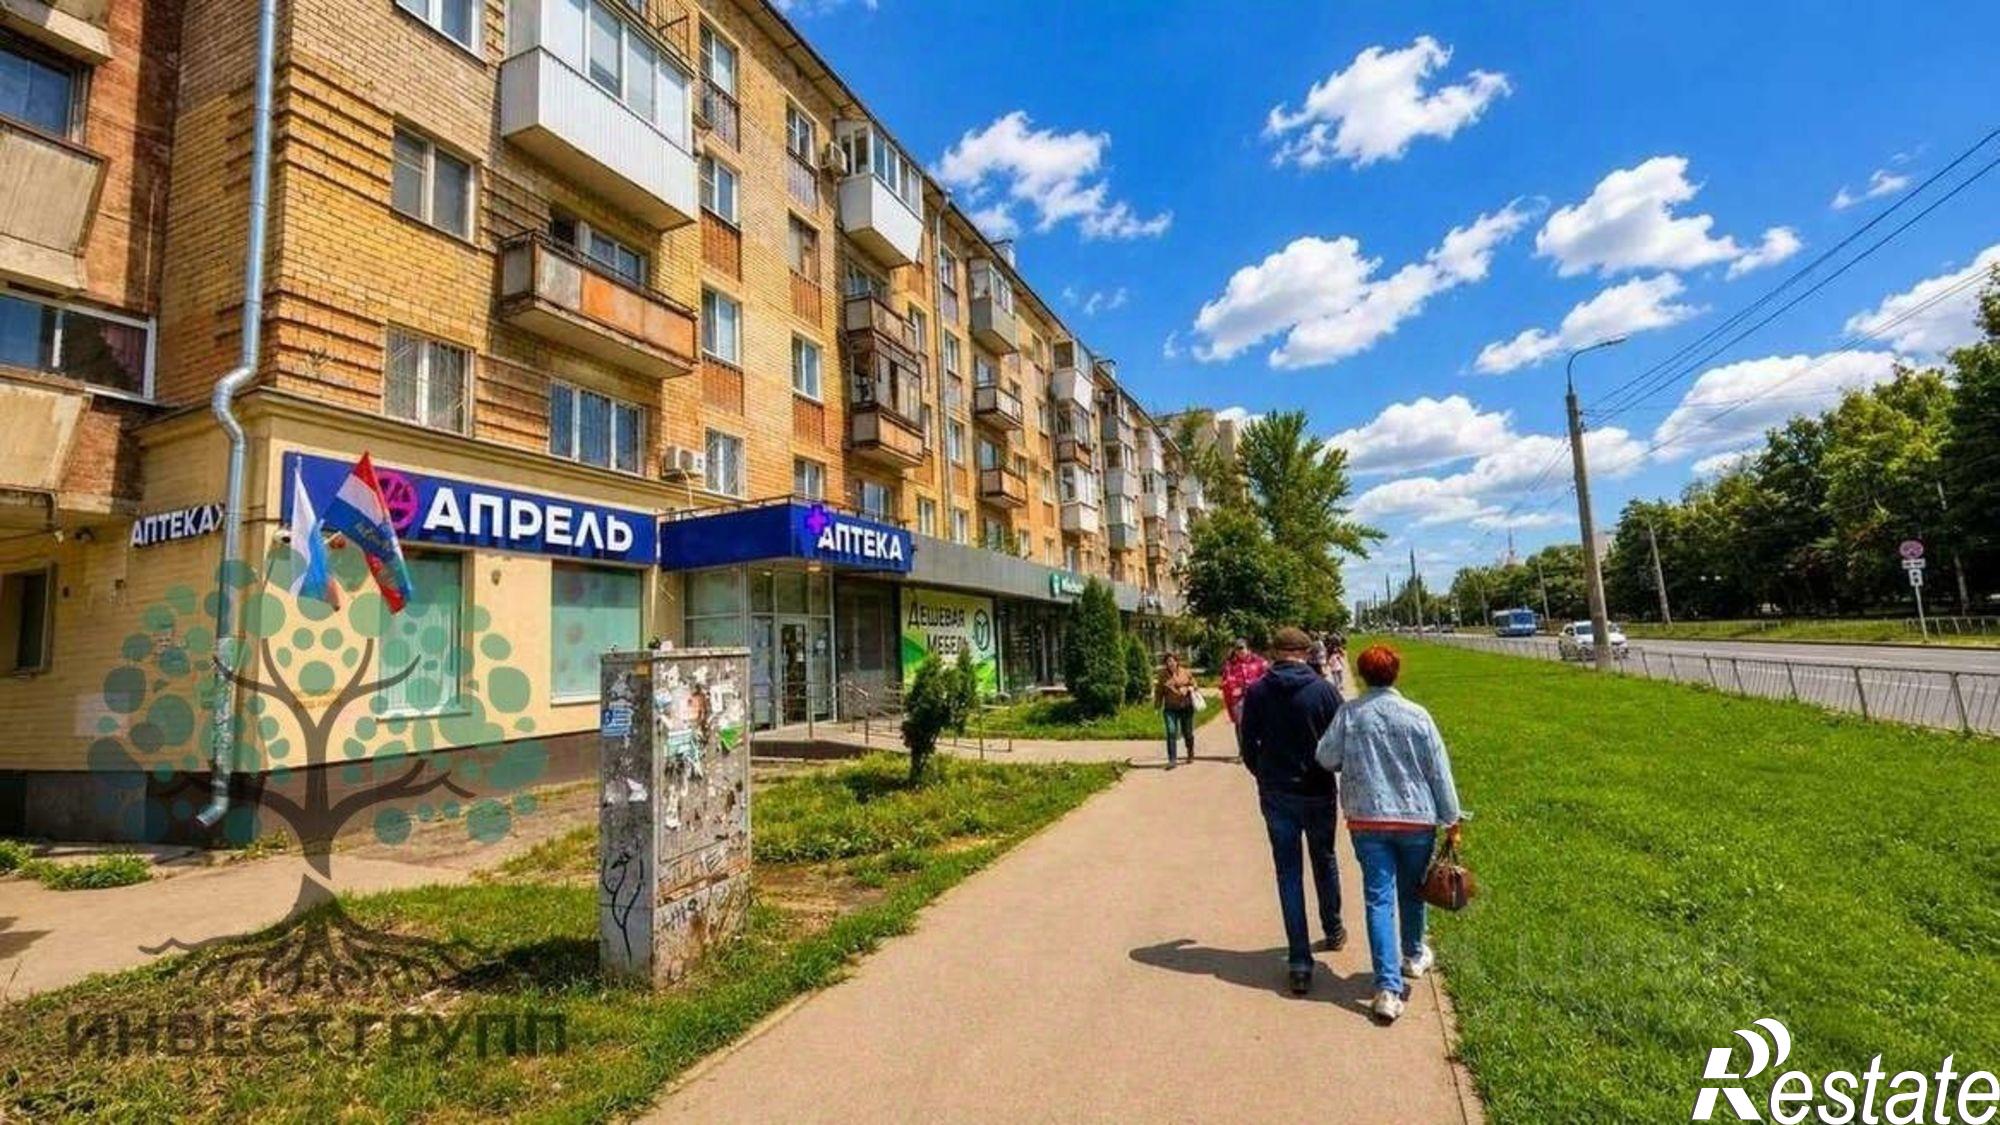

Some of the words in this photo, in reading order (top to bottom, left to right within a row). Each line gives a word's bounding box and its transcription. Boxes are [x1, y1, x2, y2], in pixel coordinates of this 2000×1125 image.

[129, 503, 216, 548] АПТЕКА
[423, 487, 633, 552] АПРЕЛЬ
[817, 521, 904, 562] АПТЕКА
